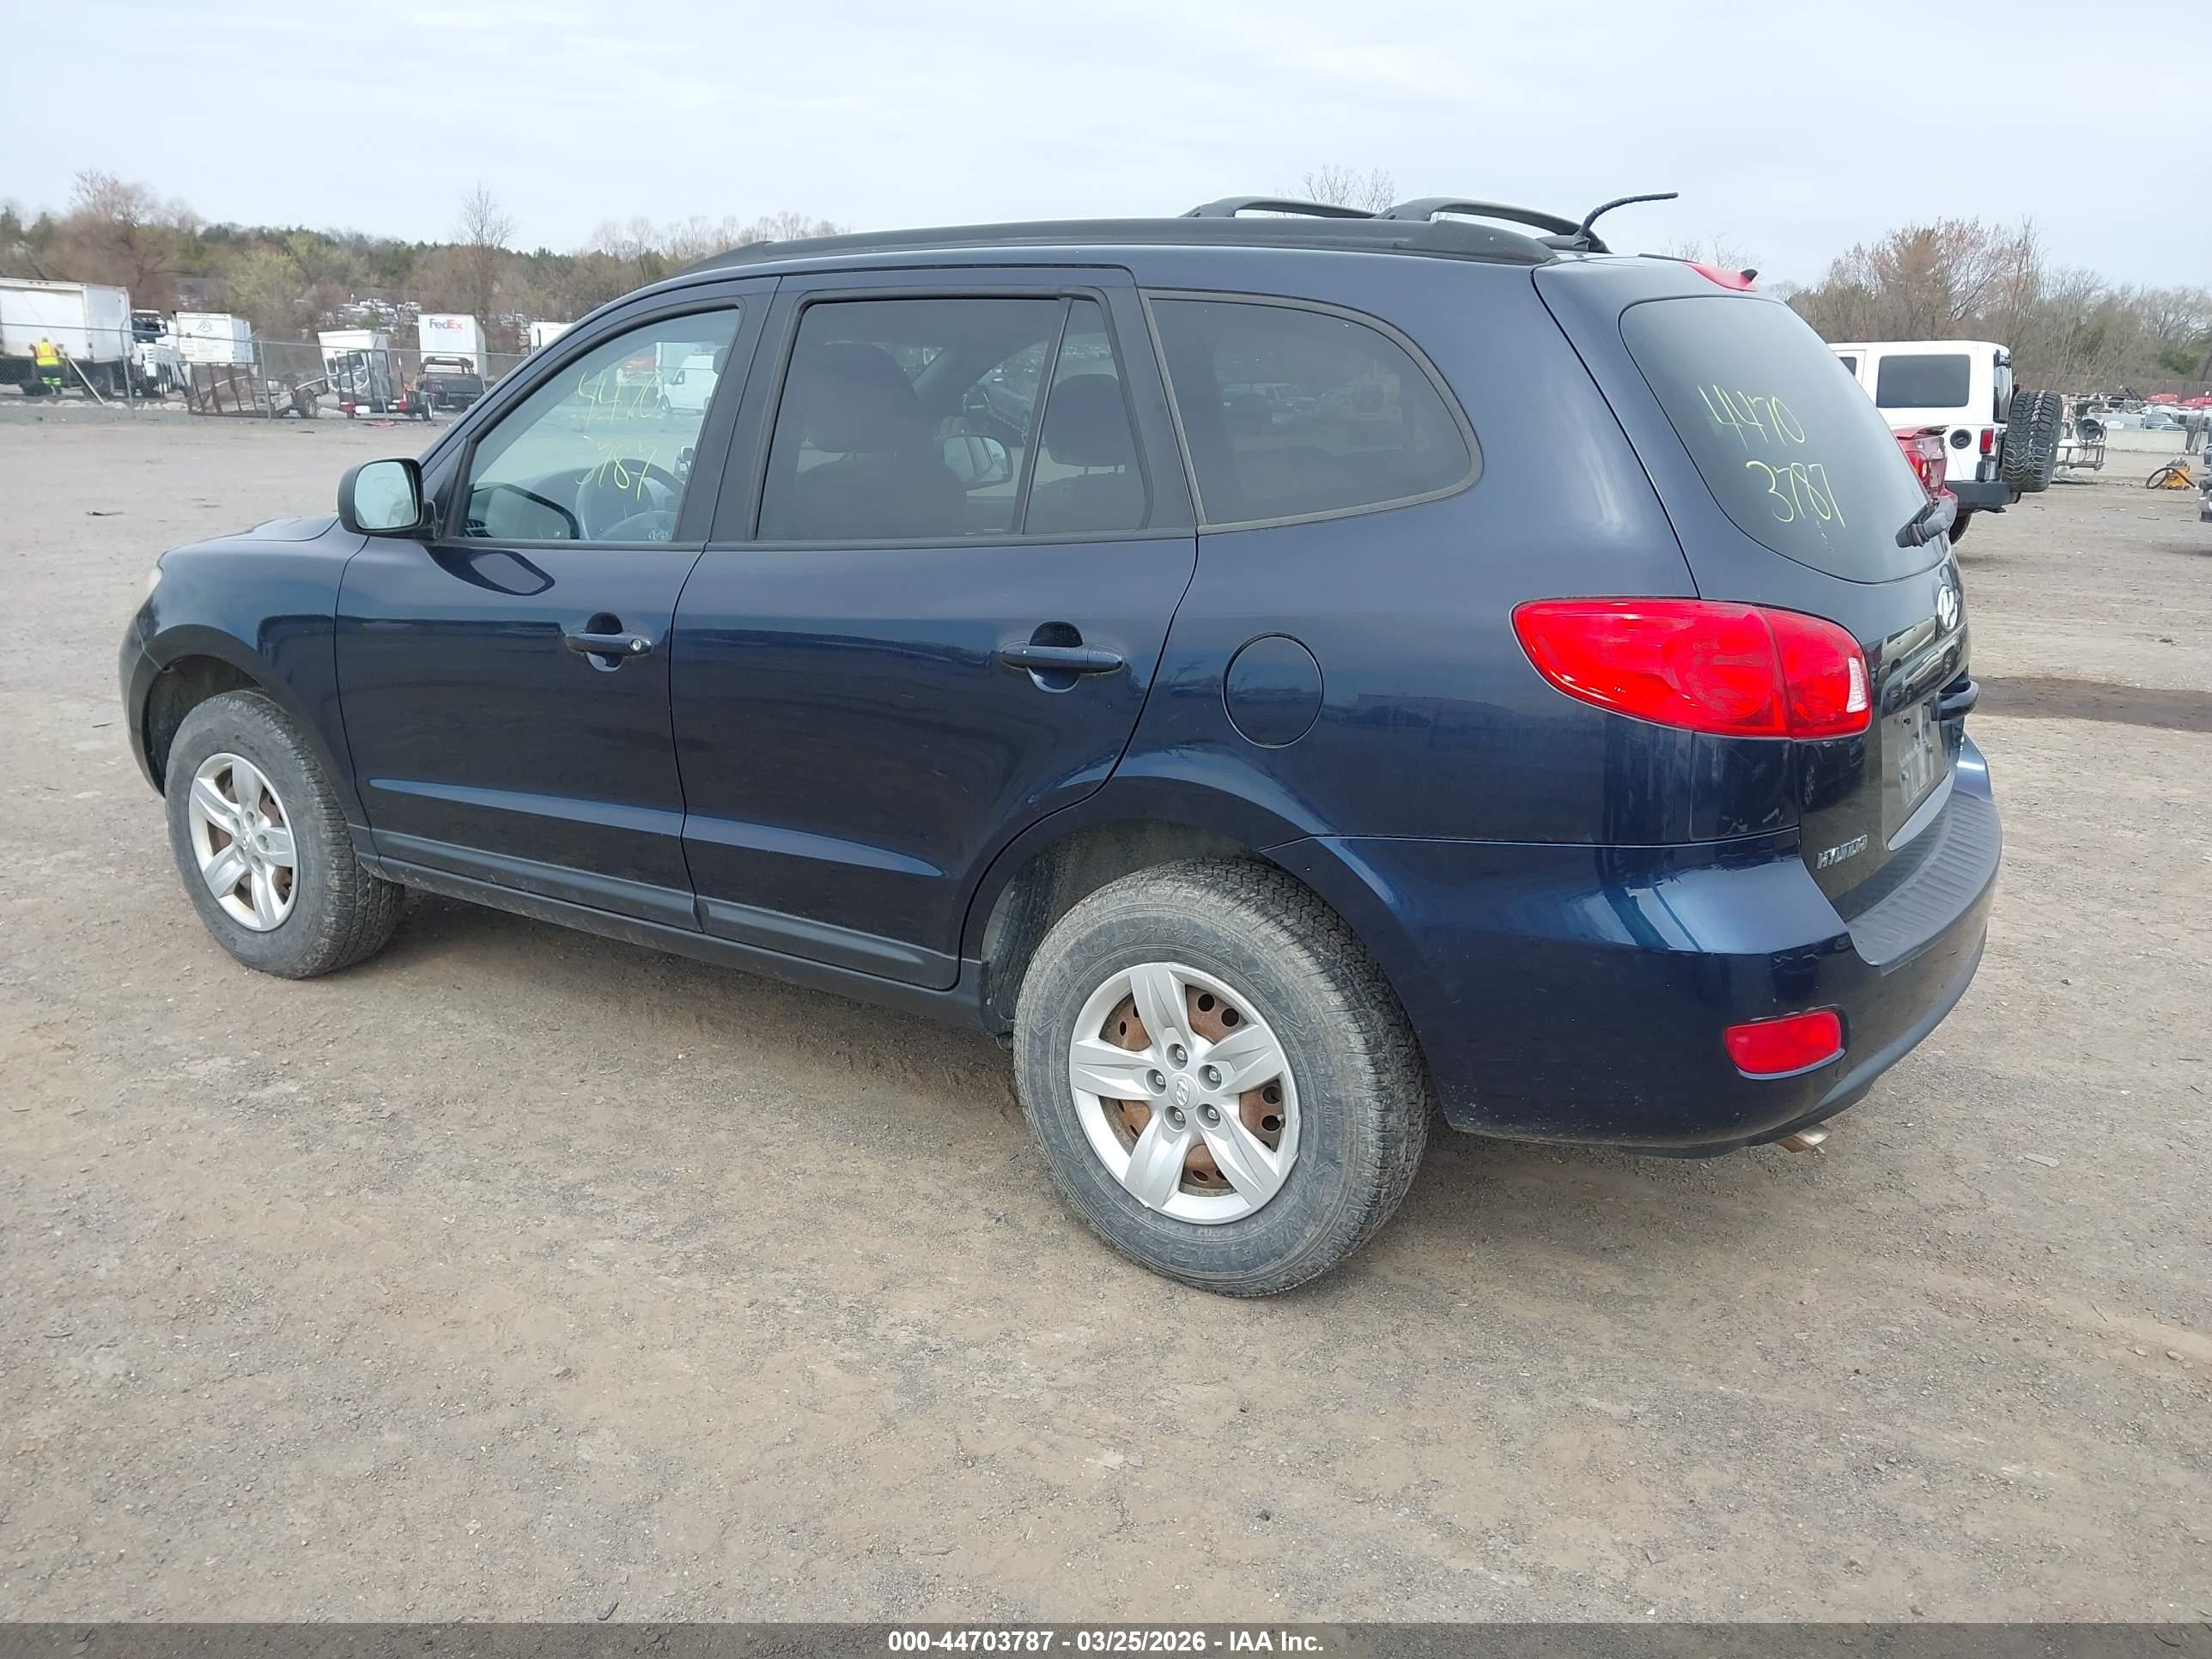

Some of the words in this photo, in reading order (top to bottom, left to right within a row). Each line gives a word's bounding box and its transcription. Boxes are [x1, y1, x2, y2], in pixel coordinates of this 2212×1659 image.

[429, 318, 463, 330] FedEx
[1698, 384, 1805, 451] 4470
[1746, 460, 1845, 527] 3787
